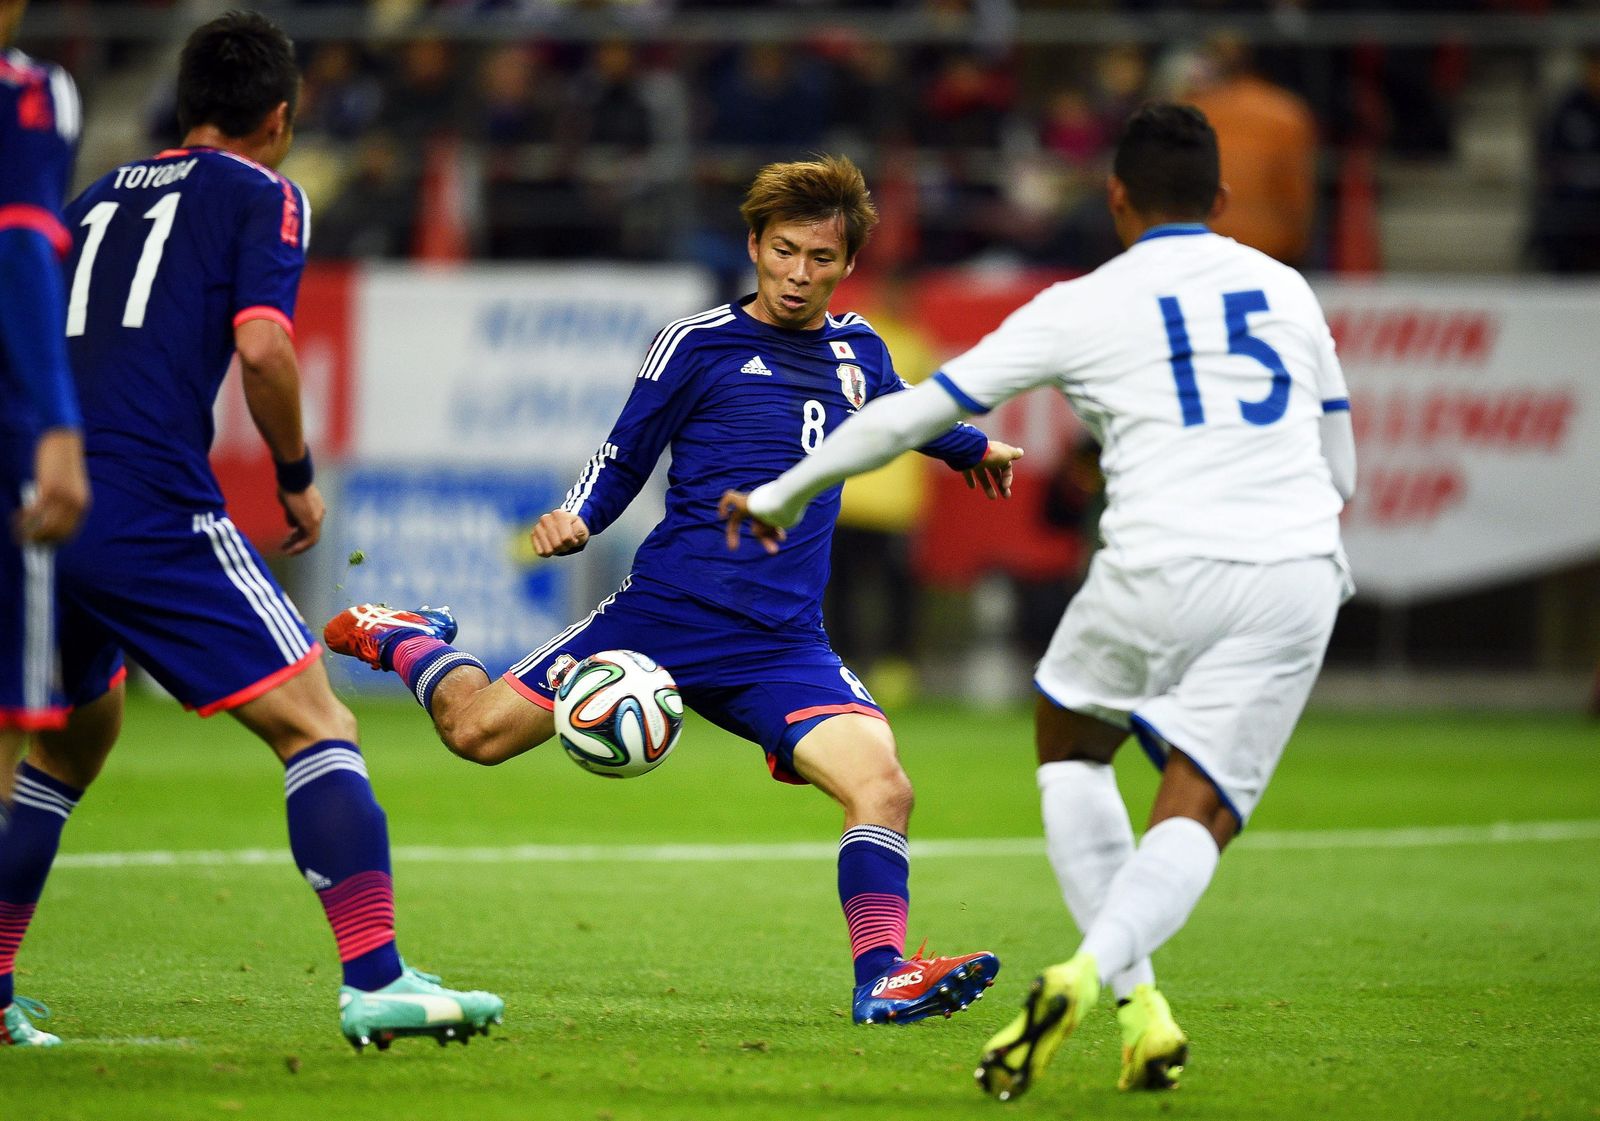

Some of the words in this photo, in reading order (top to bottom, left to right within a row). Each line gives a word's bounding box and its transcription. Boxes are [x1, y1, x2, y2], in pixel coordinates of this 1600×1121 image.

[66, 192, 181, 337] 11
[1158, 289, 1291, 428] 15
[801, 400, 826, 455] 8
[887, 969, 924, 990] asics
